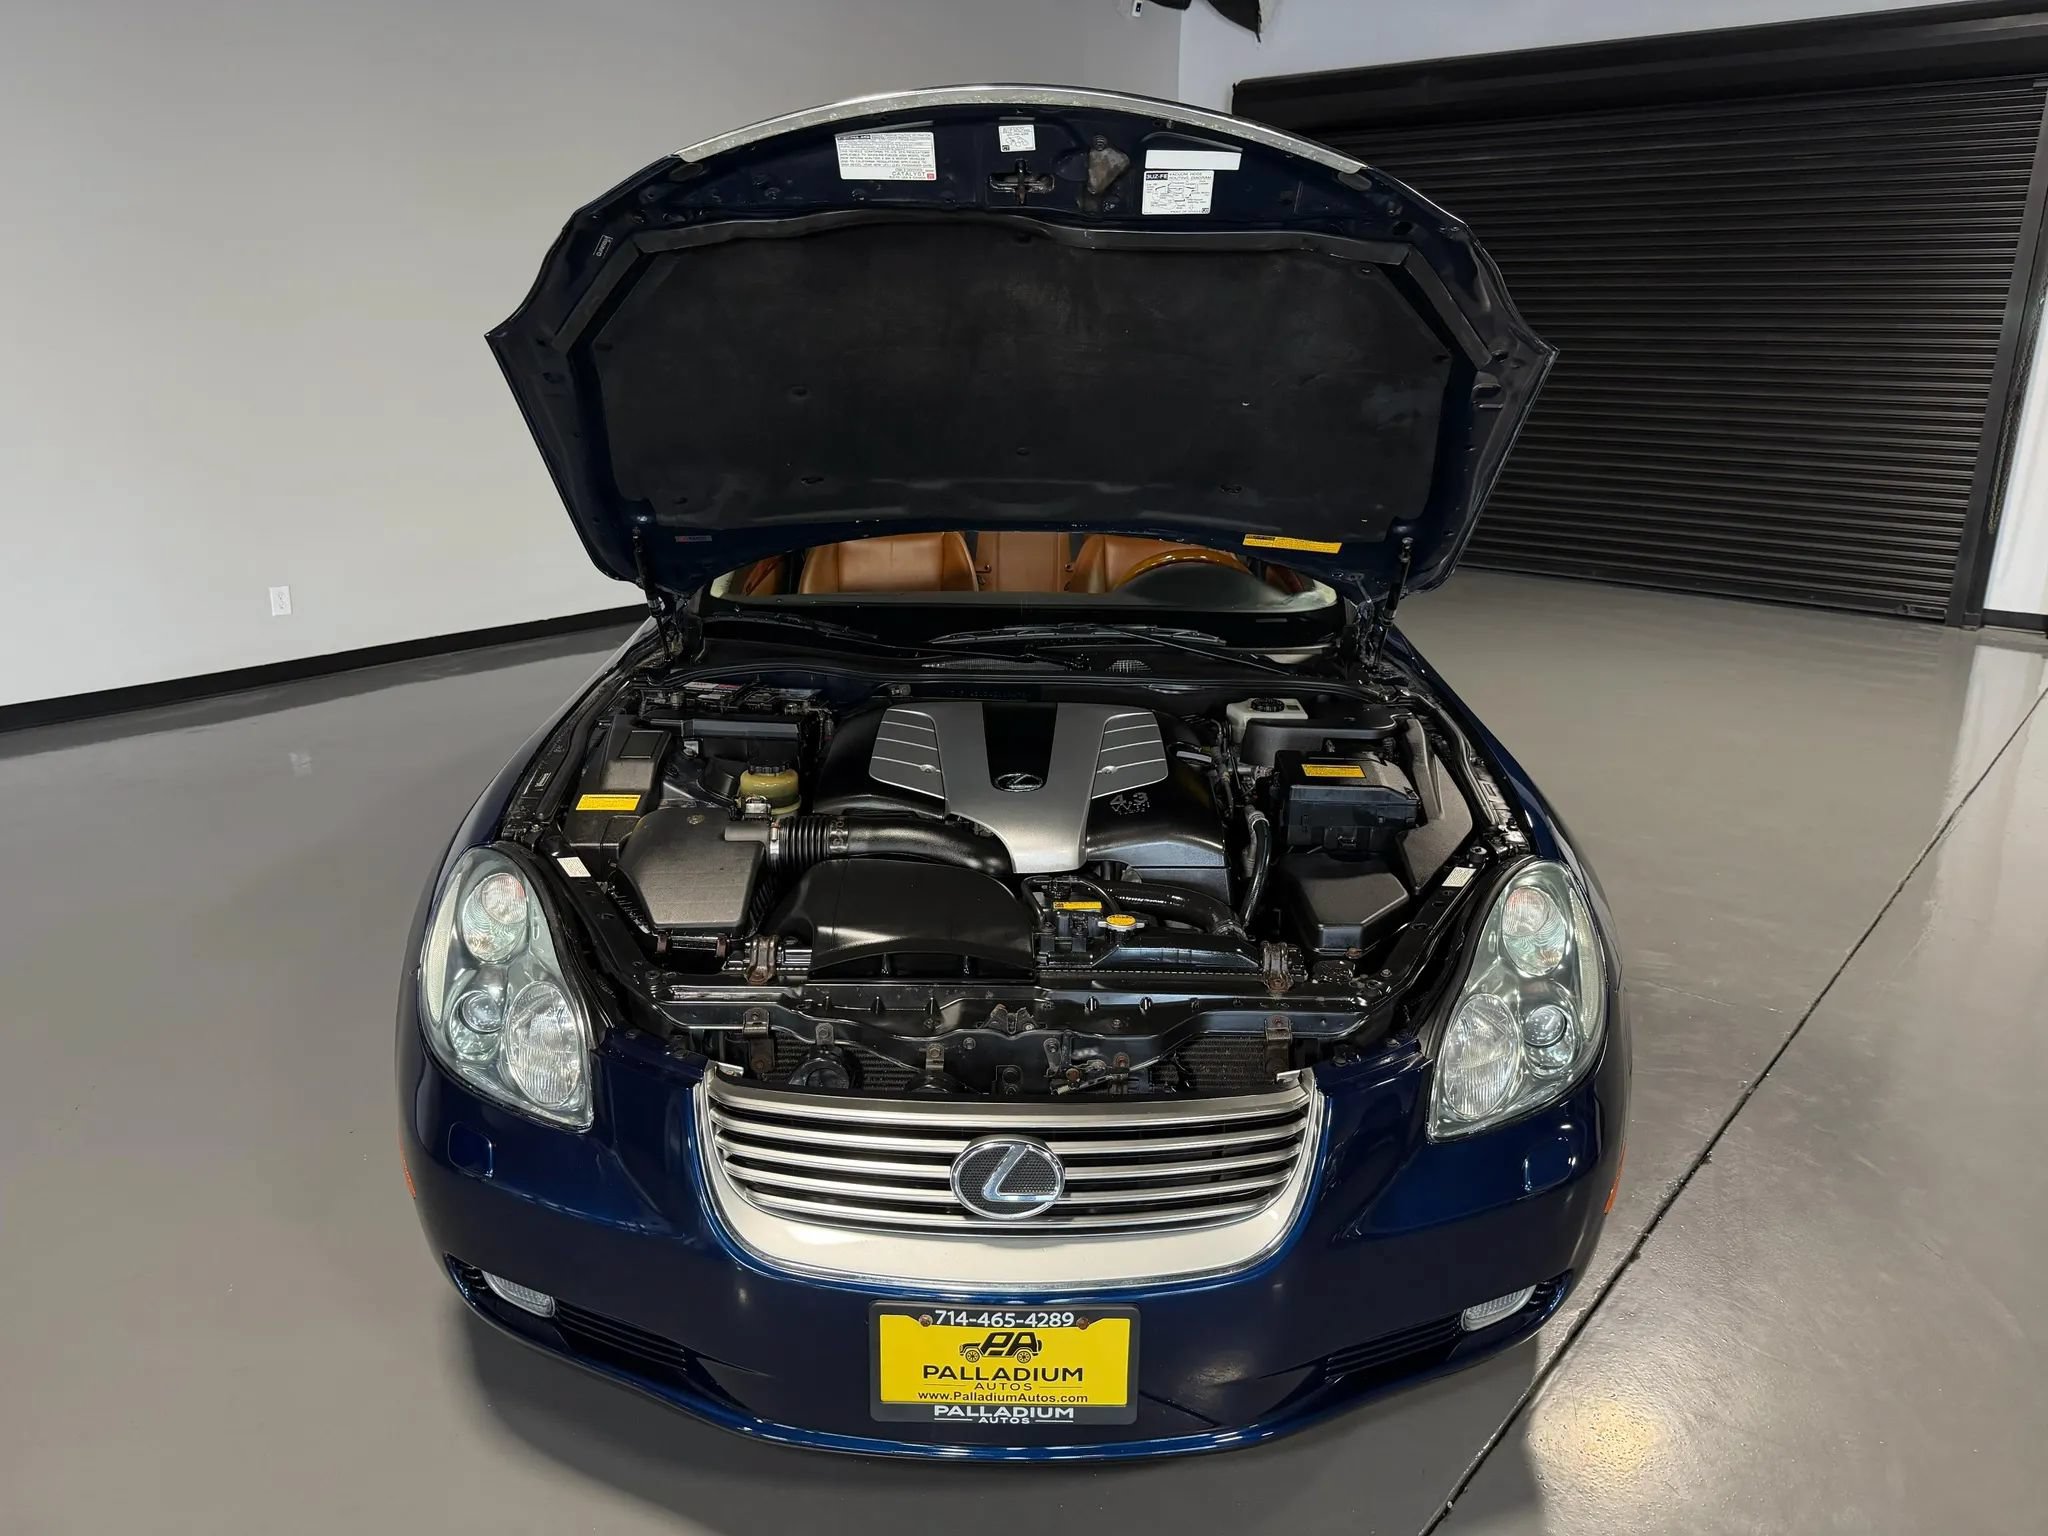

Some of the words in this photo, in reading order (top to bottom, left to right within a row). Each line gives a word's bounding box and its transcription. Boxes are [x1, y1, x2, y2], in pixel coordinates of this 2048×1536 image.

[934, 1310, 1075, 1328] 714-465-4289
[923, 1365, 1083, 1382] PALLADIUM
[974, 1382, 1033, 1391] AUTOS
[918, 1391, 1088, 1403] www.PalladiumAutos.com
[934, 1405, 1075, 1418] PALLADIUM
[979, 1417, 1030, 1425] AUTOS
